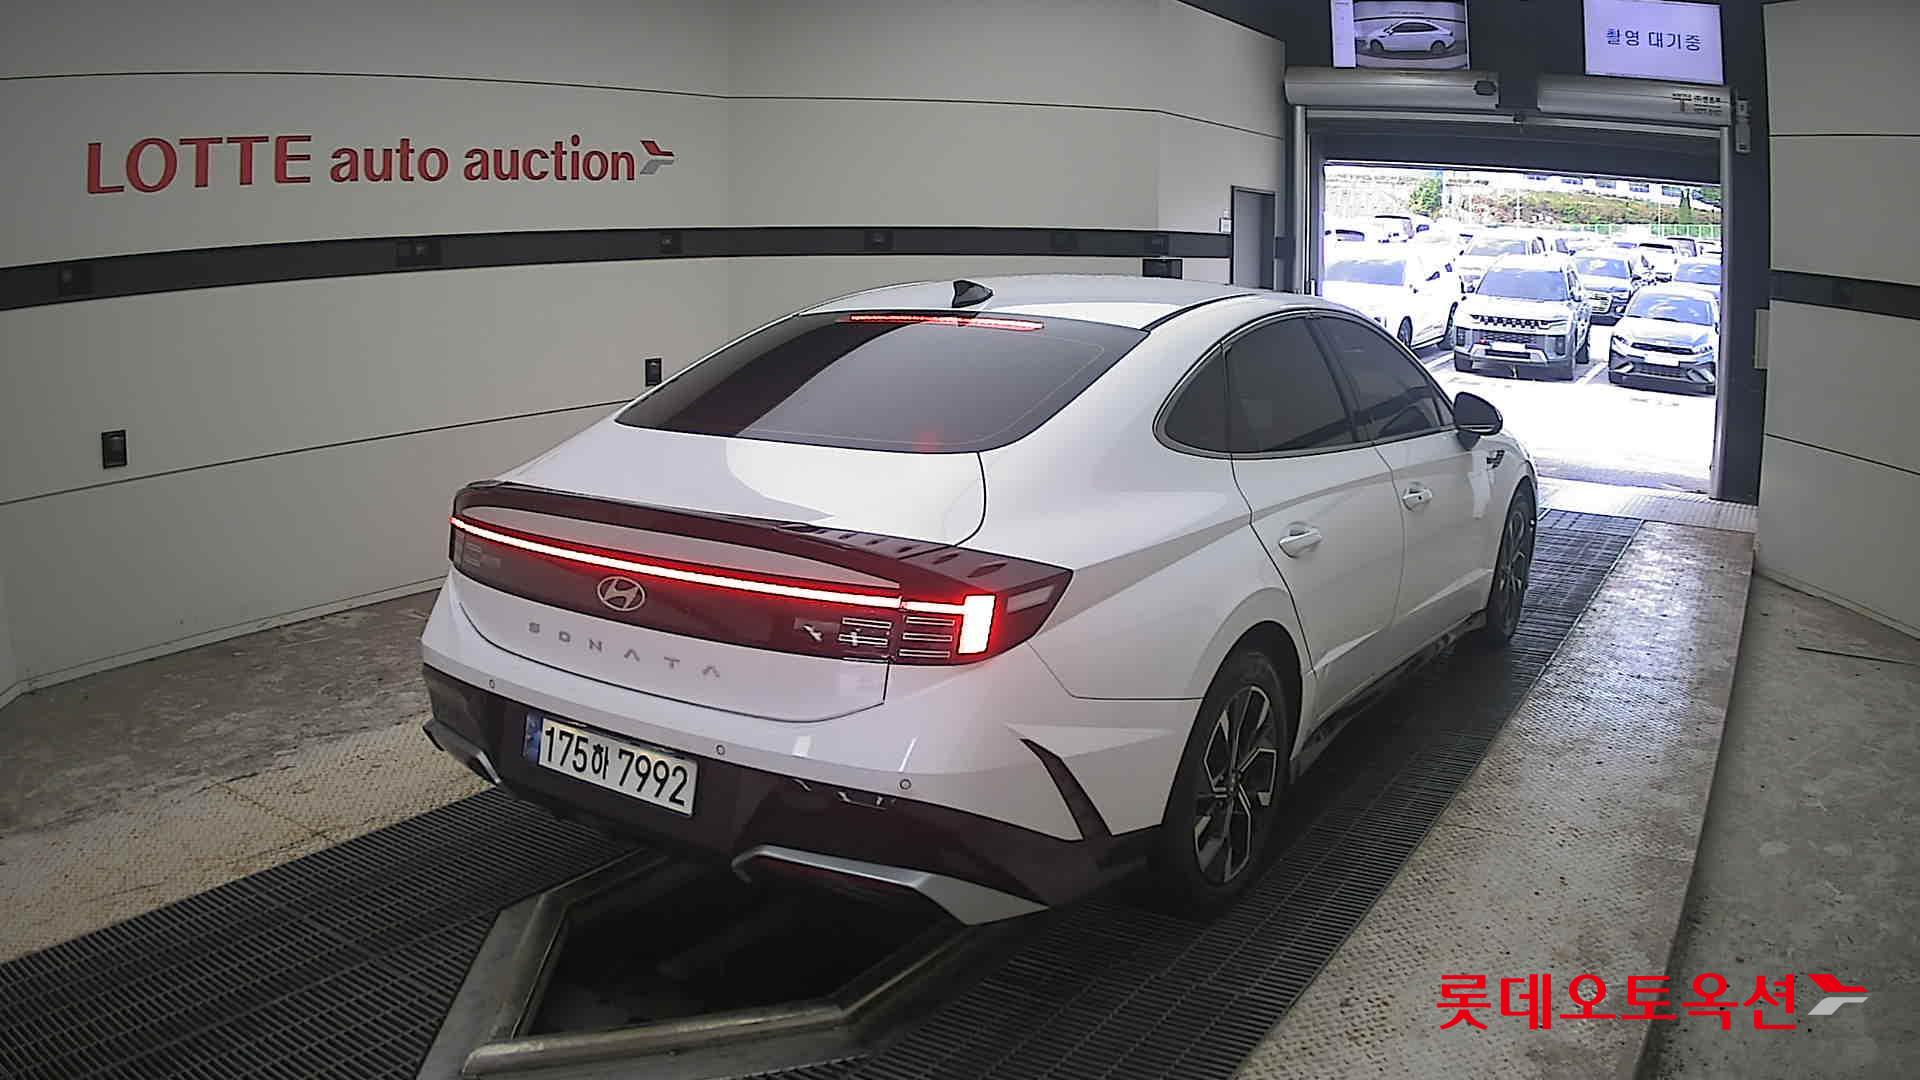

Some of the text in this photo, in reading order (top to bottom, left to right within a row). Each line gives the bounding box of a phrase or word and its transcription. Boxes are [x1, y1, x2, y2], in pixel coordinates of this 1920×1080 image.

[1647, 31, 1701, 52] 대기중
[86, 133, 636, 195] LOTTE auto auction
[528, 621, 721, 679] SONATA
[544, 726, 689, 807] 175하 7992
